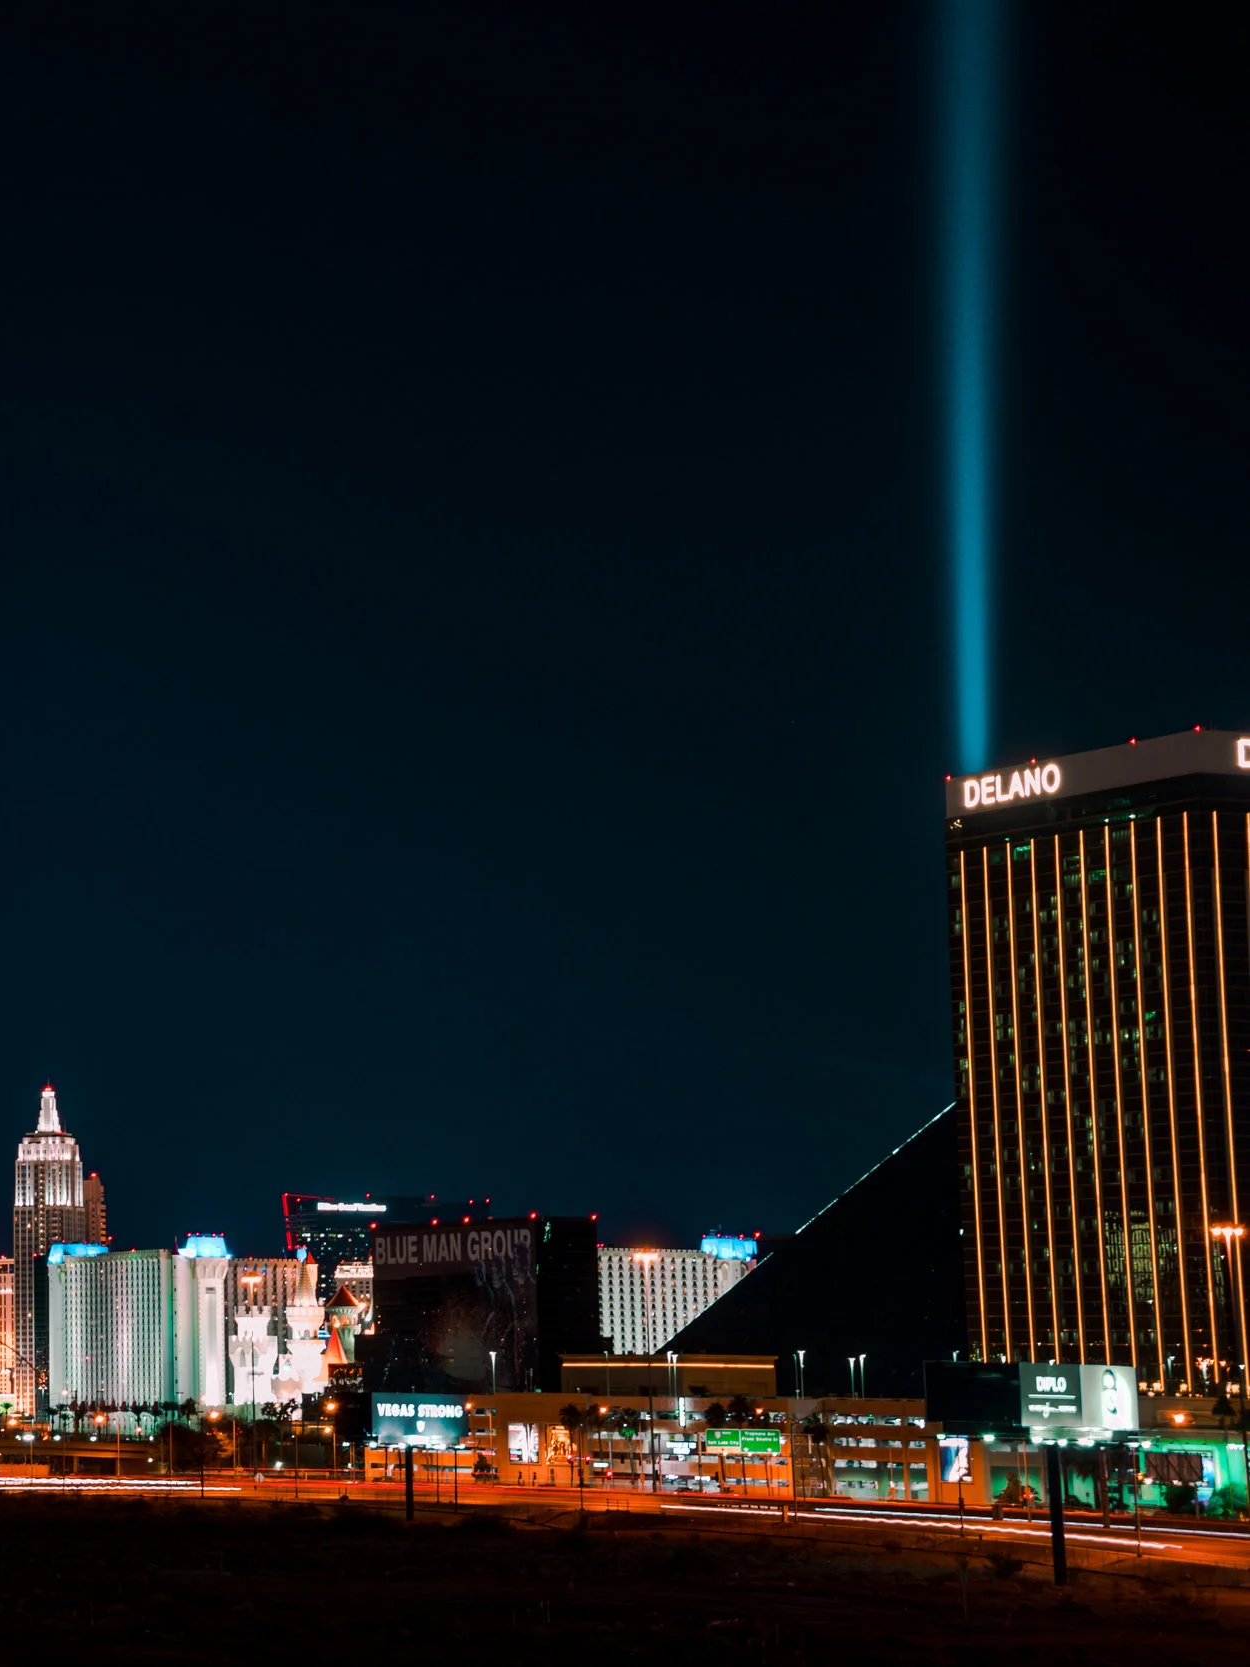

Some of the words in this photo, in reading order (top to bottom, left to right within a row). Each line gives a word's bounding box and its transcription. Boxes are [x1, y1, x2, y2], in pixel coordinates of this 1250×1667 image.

[963, 763, 1061, 808] DELANO
[375, 1235, 418, 1265] BLUE
[423, 1232, 462, 1262] MAN
[1035, 1376, 1067, 1392] DIPLO
[376, 1403, 416, 1418] VEGAS
[417, 1404, 464, 1418] STRONG
